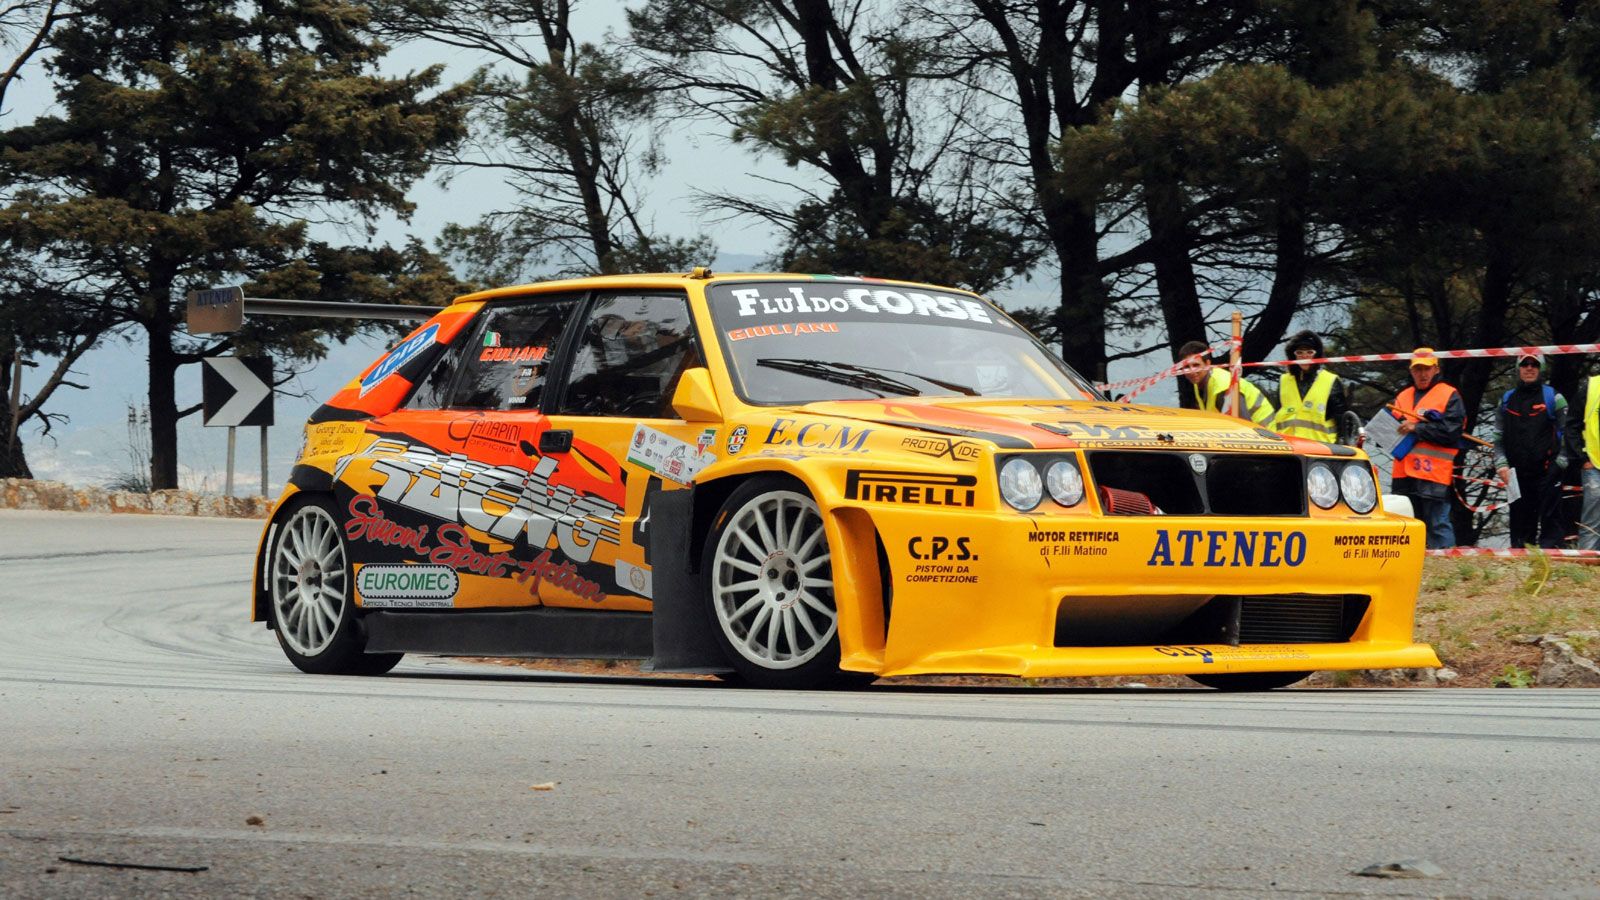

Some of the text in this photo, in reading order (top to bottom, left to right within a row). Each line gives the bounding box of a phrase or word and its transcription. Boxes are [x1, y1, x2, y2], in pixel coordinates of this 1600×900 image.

[843, 288, 993, 324] CORSE
[728, 322, 840, 341] GIULIANI
[480, 346, 548, 364] GIULIANI
[763, 418, 875, 453] E.C.M.
[469, 439, 516, 454] OFFICINA
[900, 437, 982, 461] PROTOXIDE
[1413, 458, 1432, 472] 33
[844, 469, 978, 507] PIRELLI
[1028, 532, 1119, 542] MOTOR RETTIFICA
[1334, 535, 1410, 546] MOTOR RETTIFICA
[344, 494, 607, 603] Simoni Sport Action
[908, 536, 979, 561] C.P.S.
[1040, 546, 1049, 556] di
[1074, 546, 1107, 556] Matino
[1147, 529, 1307, 567] ATENEO
[1343, 549, 1352, 559] di
[1371, 548, 1400, 558] Matino
[915, 565, 969, 573] PISTONI DA
[363, 572, 450, 591] EUROMEC
[906, 574, 979, 583] COMPETIZIONE
